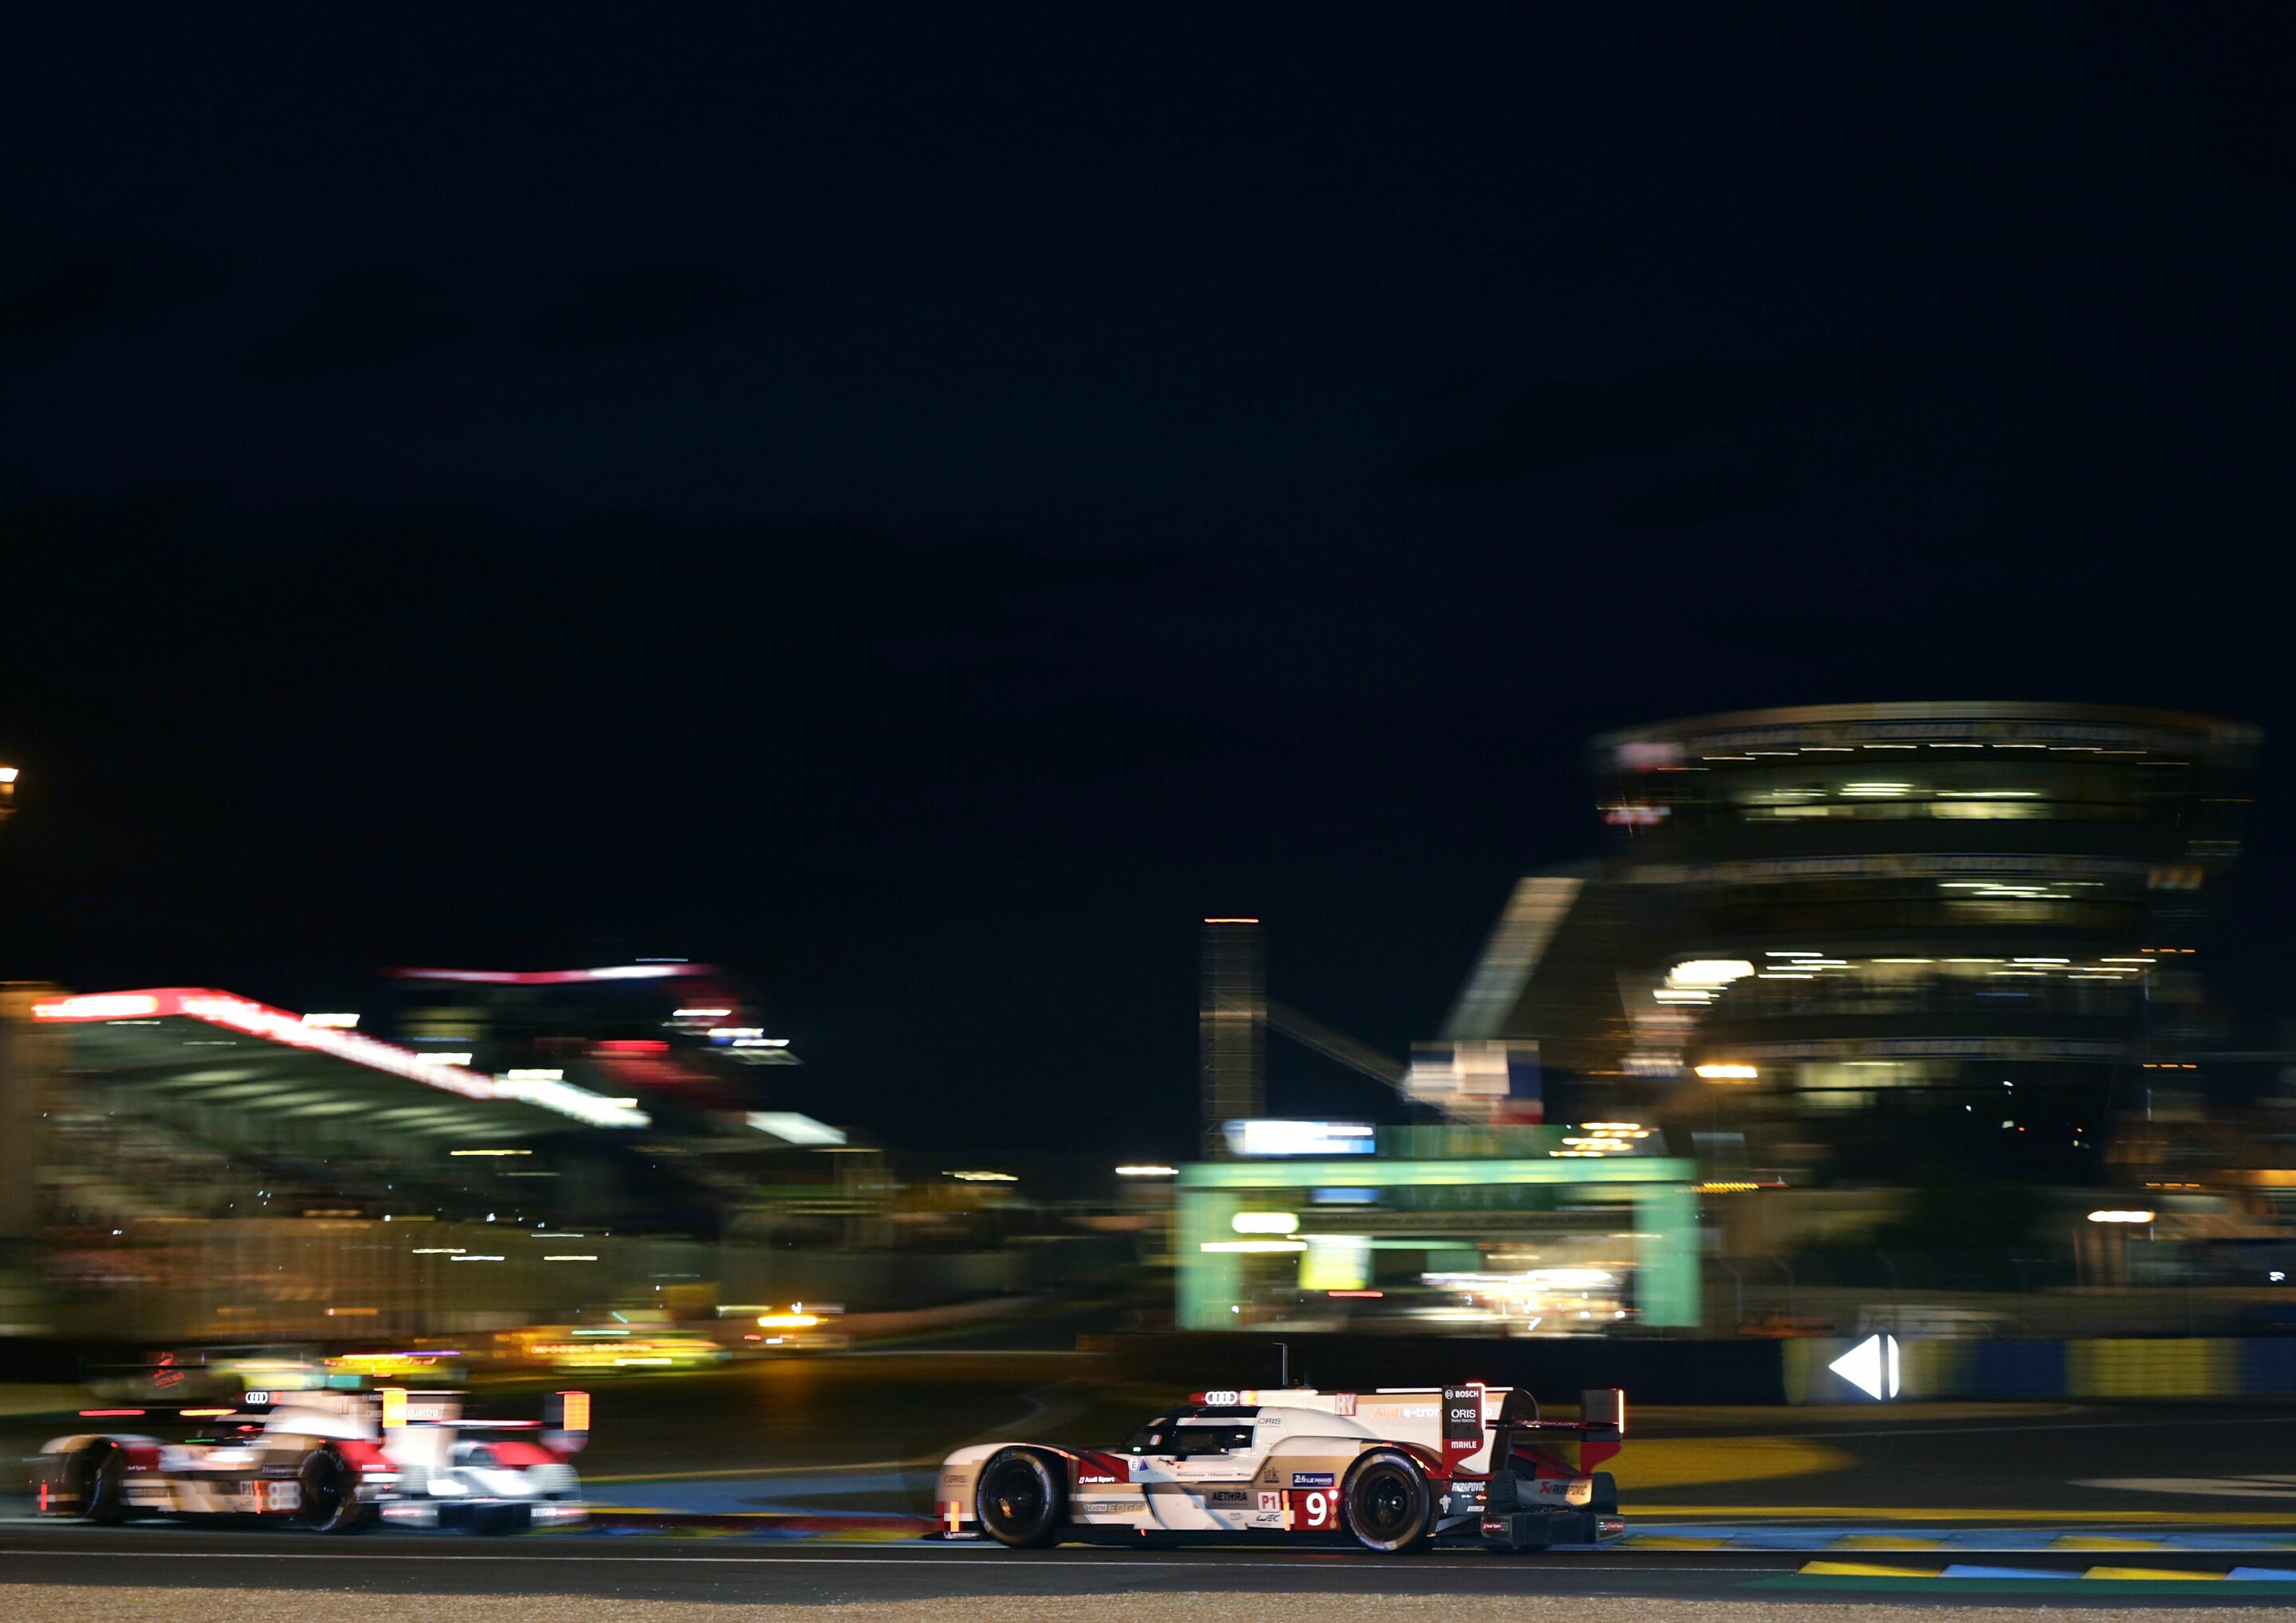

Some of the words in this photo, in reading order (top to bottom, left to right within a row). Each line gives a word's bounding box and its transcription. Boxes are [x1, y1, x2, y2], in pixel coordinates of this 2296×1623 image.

[1336, 1394, 1355, 1416] HY
[407, 1408, 439, 1420] quattro
[1372, 1407, 1402, 1418] Audi
[1451, 1409, 1476, 1418] ORIS
[1212, 1491, 1248, 1501] AETHRA
[1108, 1503, 1142, 1512] EDGE
[1262, 1495, 1276, 1509] P1
[1305, 1491, 1327, 1527] 9
